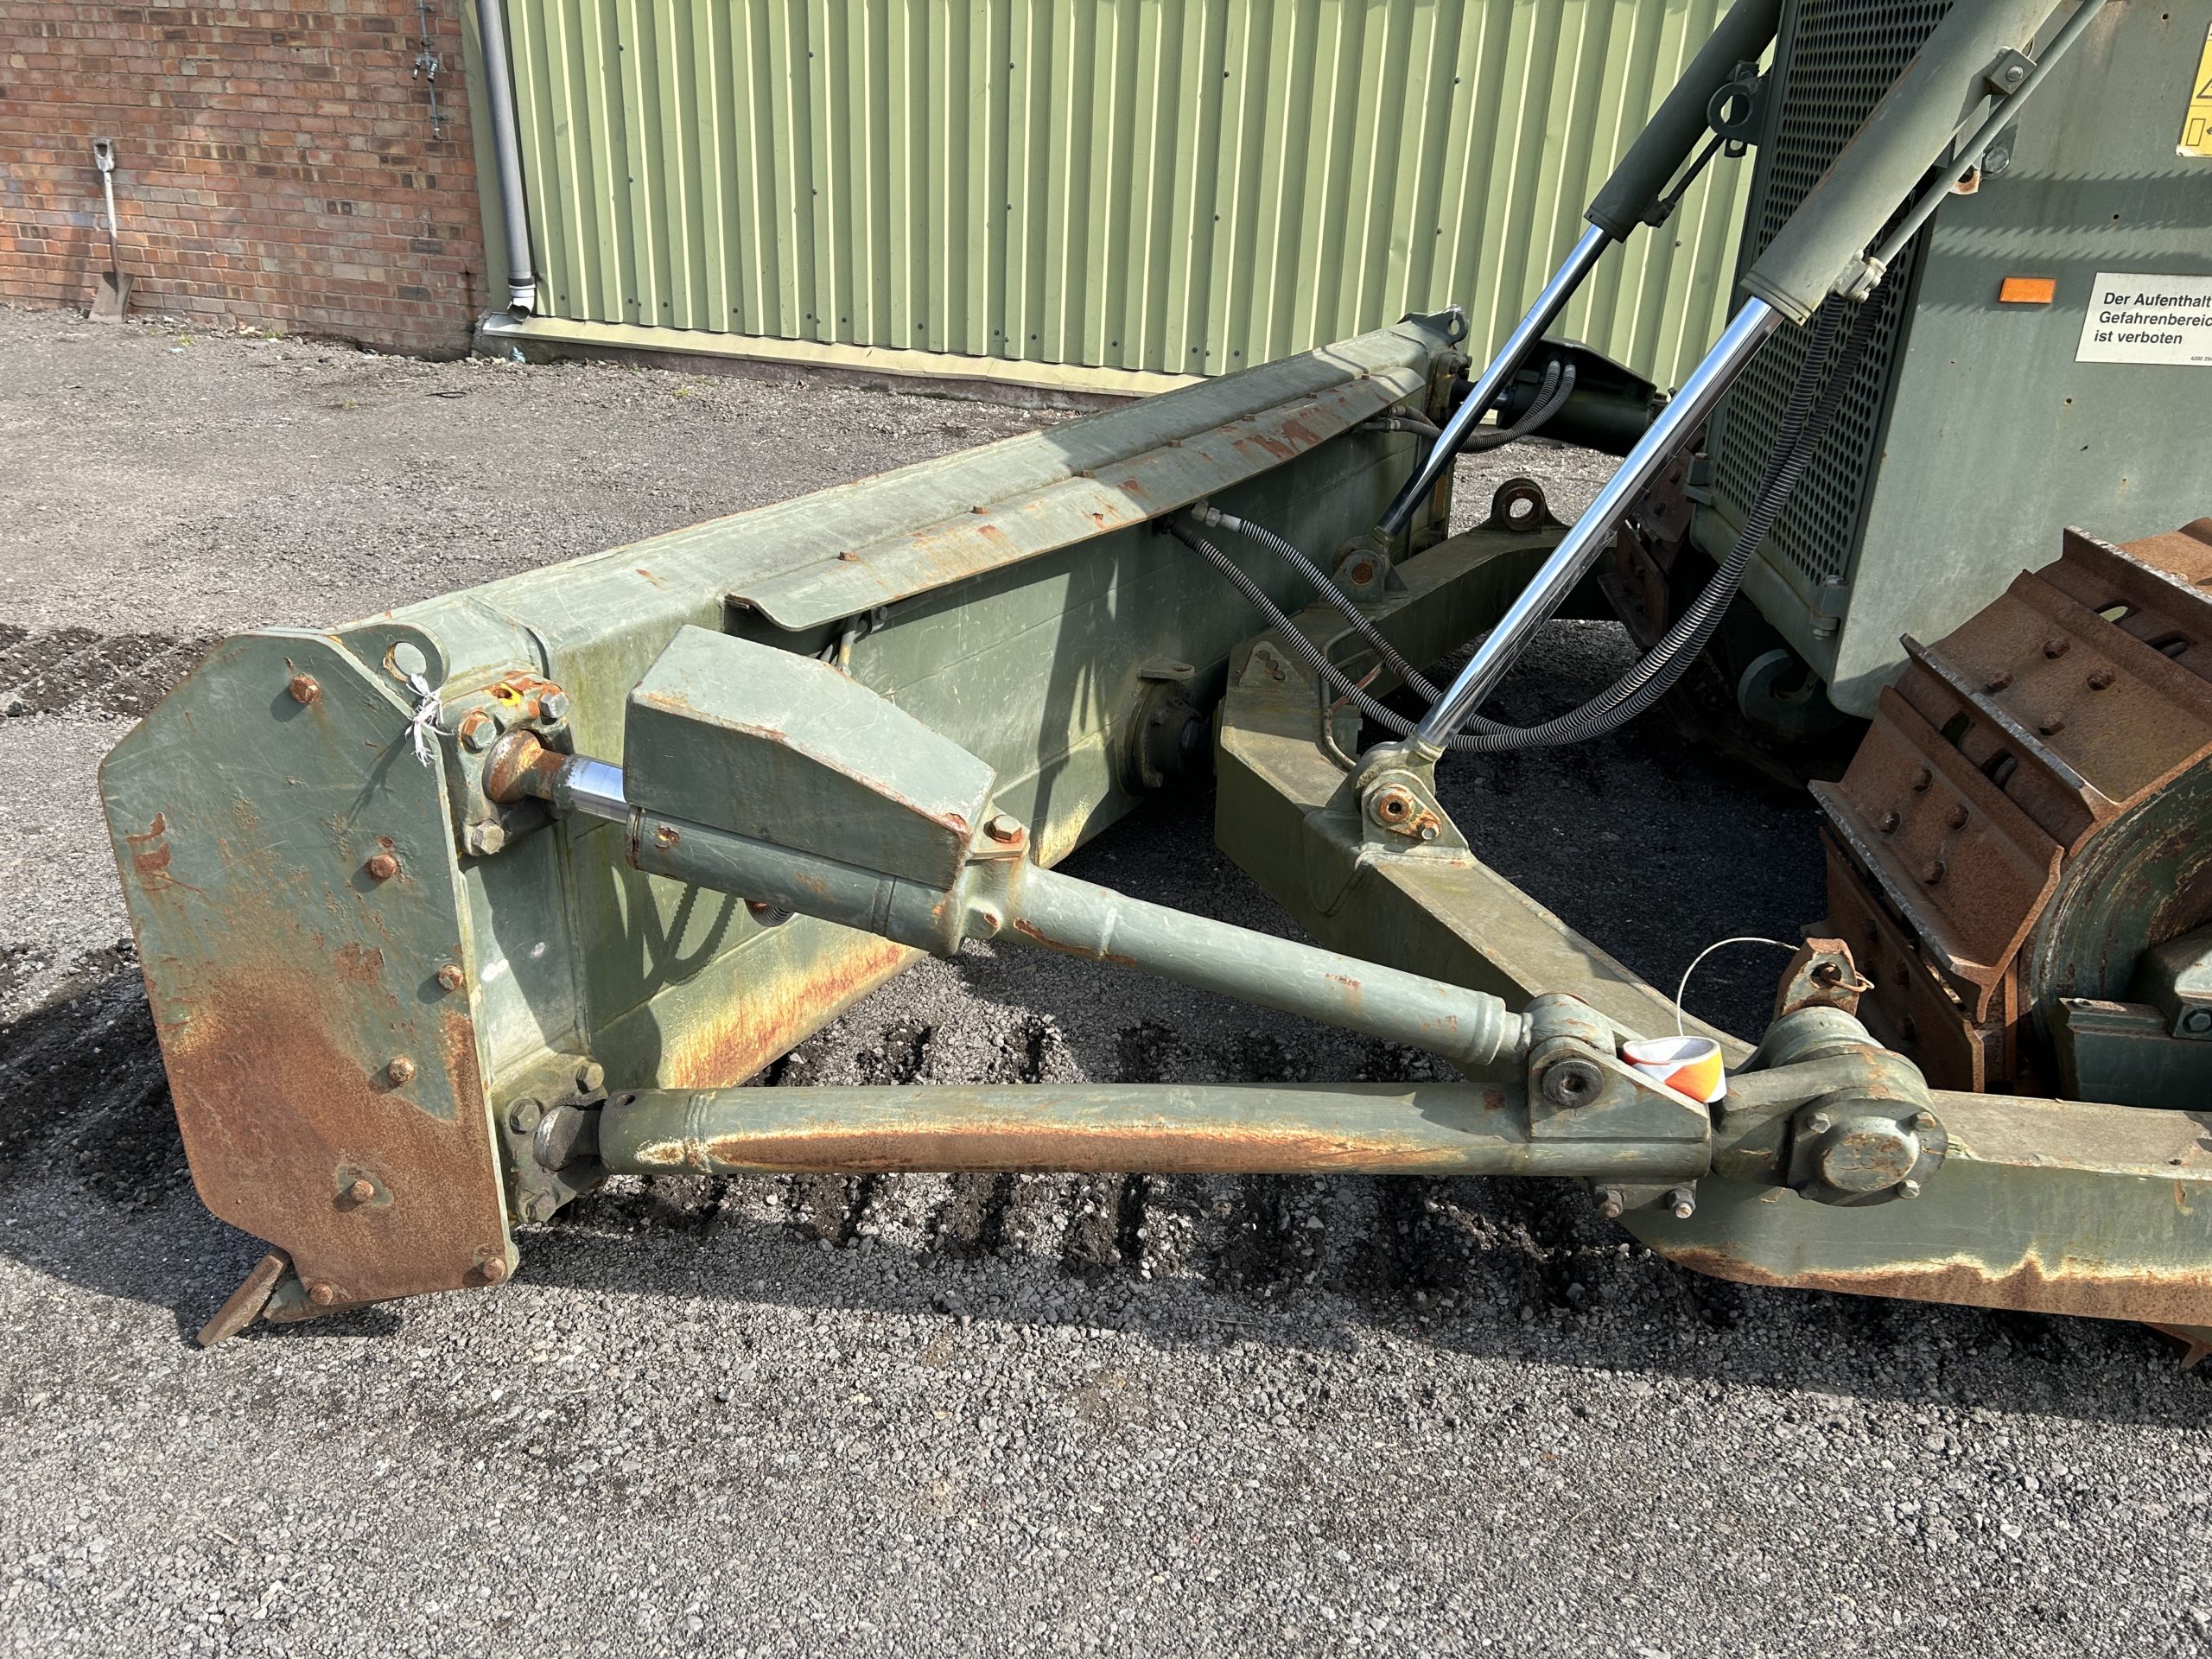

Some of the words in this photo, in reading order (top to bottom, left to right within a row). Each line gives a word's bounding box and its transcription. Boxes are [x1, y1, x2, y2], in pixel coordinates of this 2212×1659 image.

[2103, 292, 2131, 305] Der
[2133, 293, 2212, 308] Aufenthalt
[2094, 329, 2113, 342] ist
[2118, 331, 2183, 345] verboten
